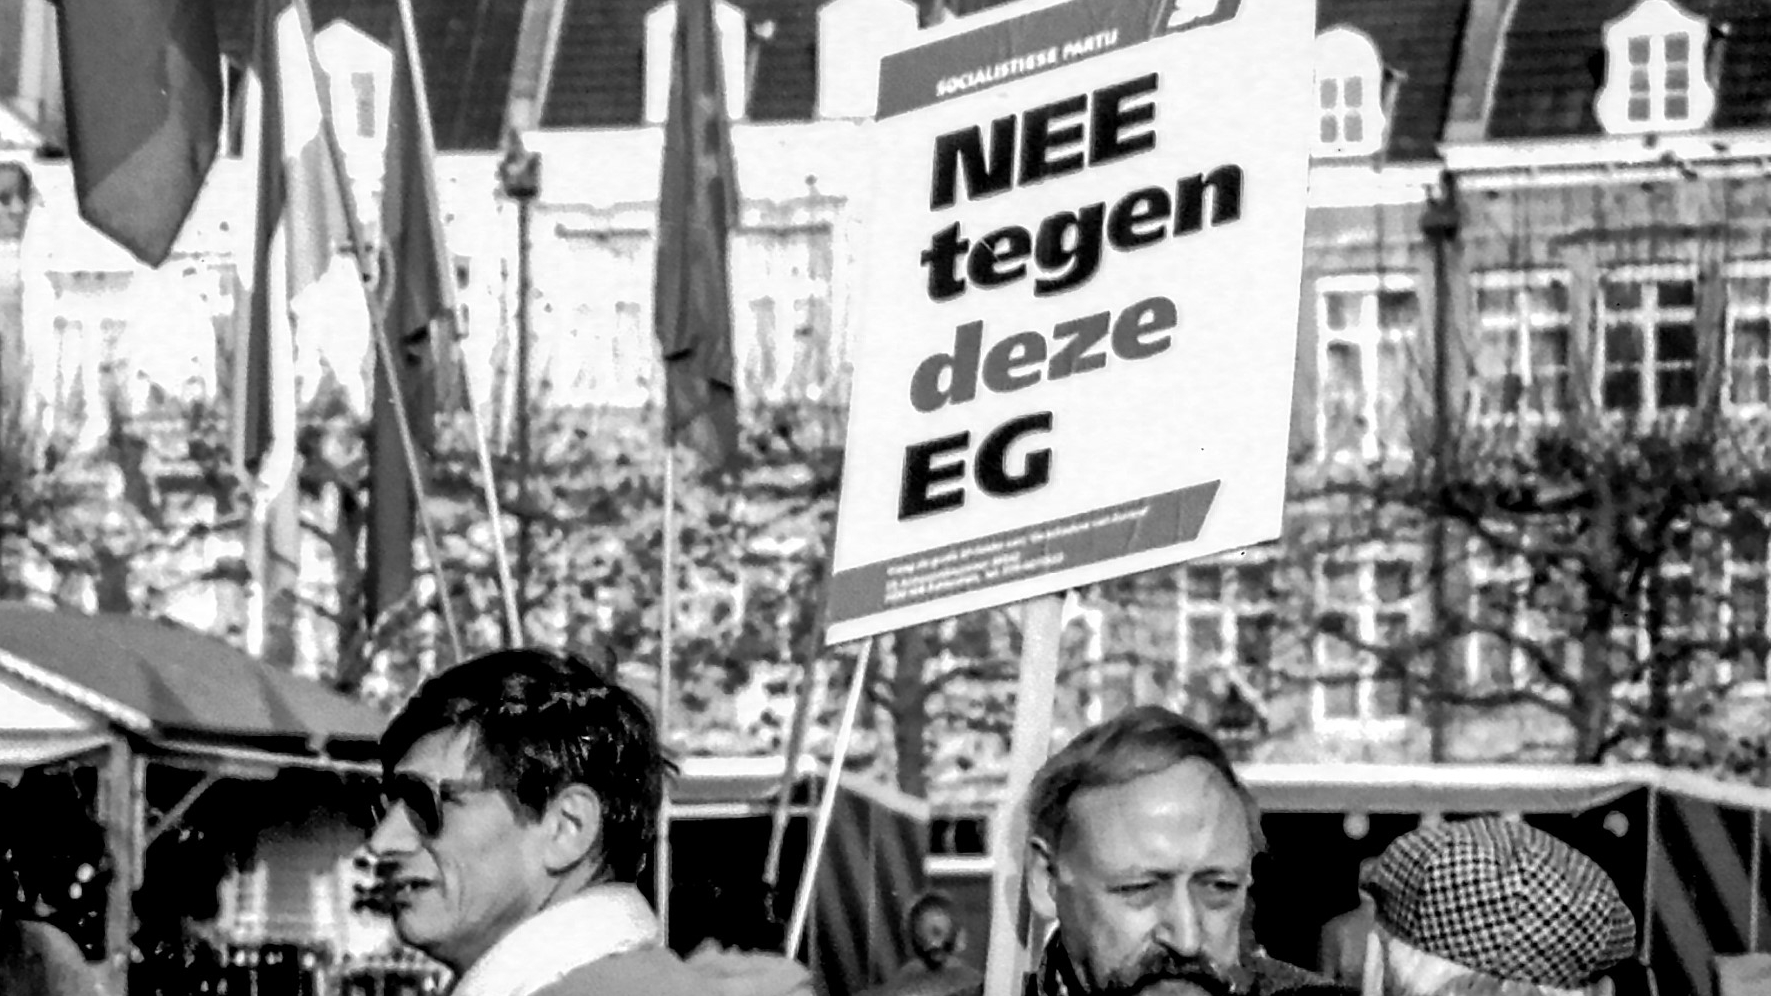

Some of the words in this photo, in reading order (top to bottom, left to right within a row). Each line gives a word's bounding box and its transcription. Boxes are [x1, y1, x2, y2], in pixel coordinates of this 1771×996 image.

[930, 72, 1160, 212] NEE
[920, 163, 1245, 303] tegen
[909, 296, 1178, 414] deze
[898, 411, 1054, 522] EG
